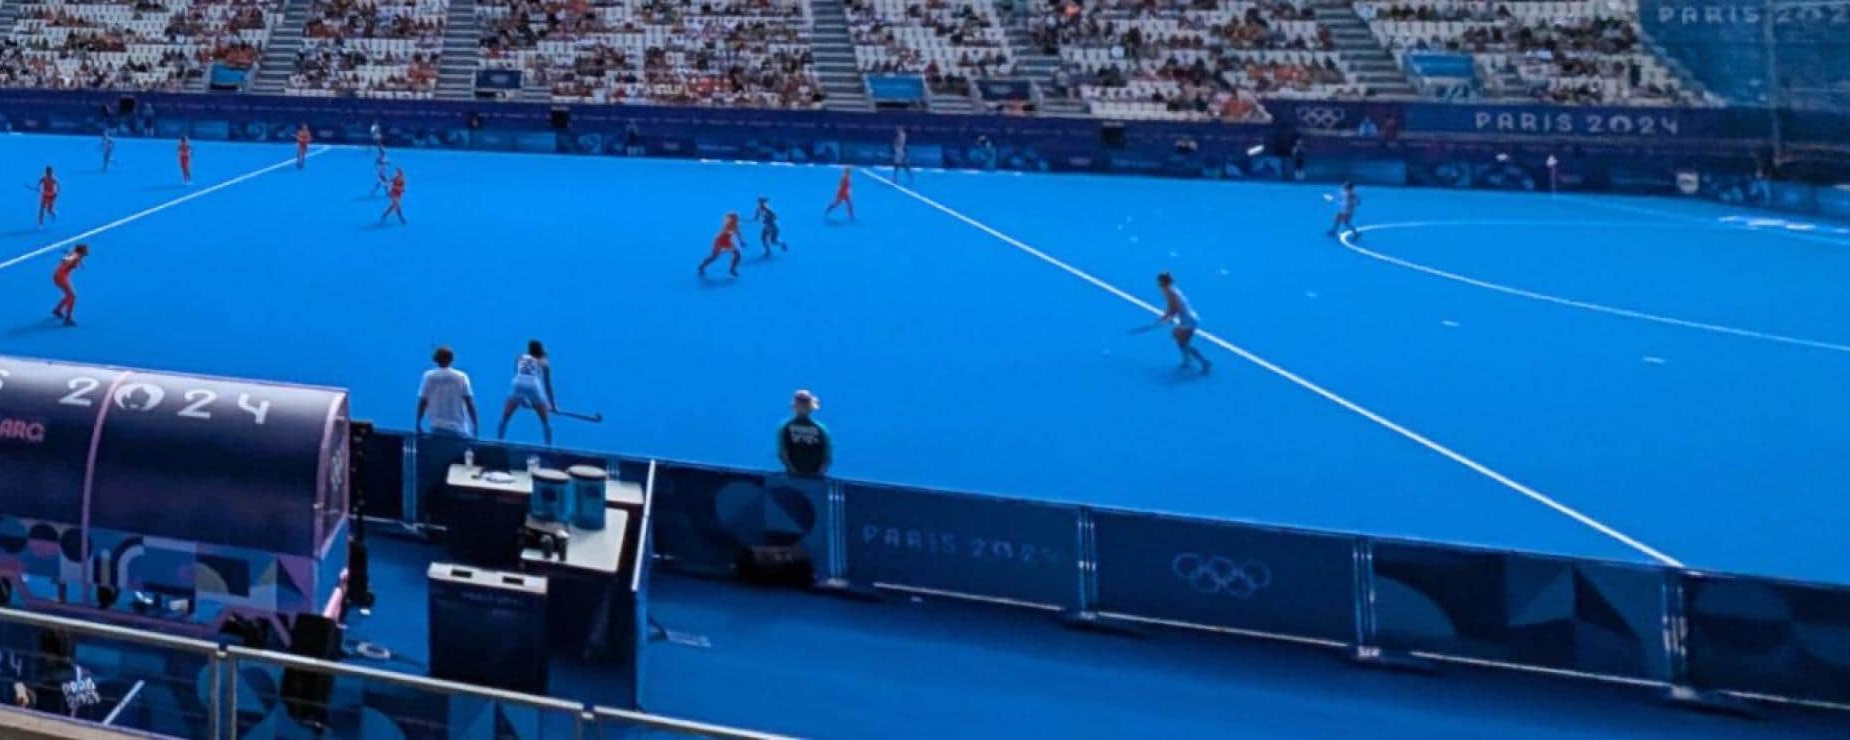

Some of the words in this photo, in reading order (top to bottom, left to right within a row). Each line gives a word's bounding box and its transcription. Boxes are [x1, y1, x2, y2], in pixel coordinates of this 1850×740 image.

[1475, 111, 1573, 132] PARIS
[1586, 114, 1679, 134] 2024
[58, 376, 270, 425] 2024
